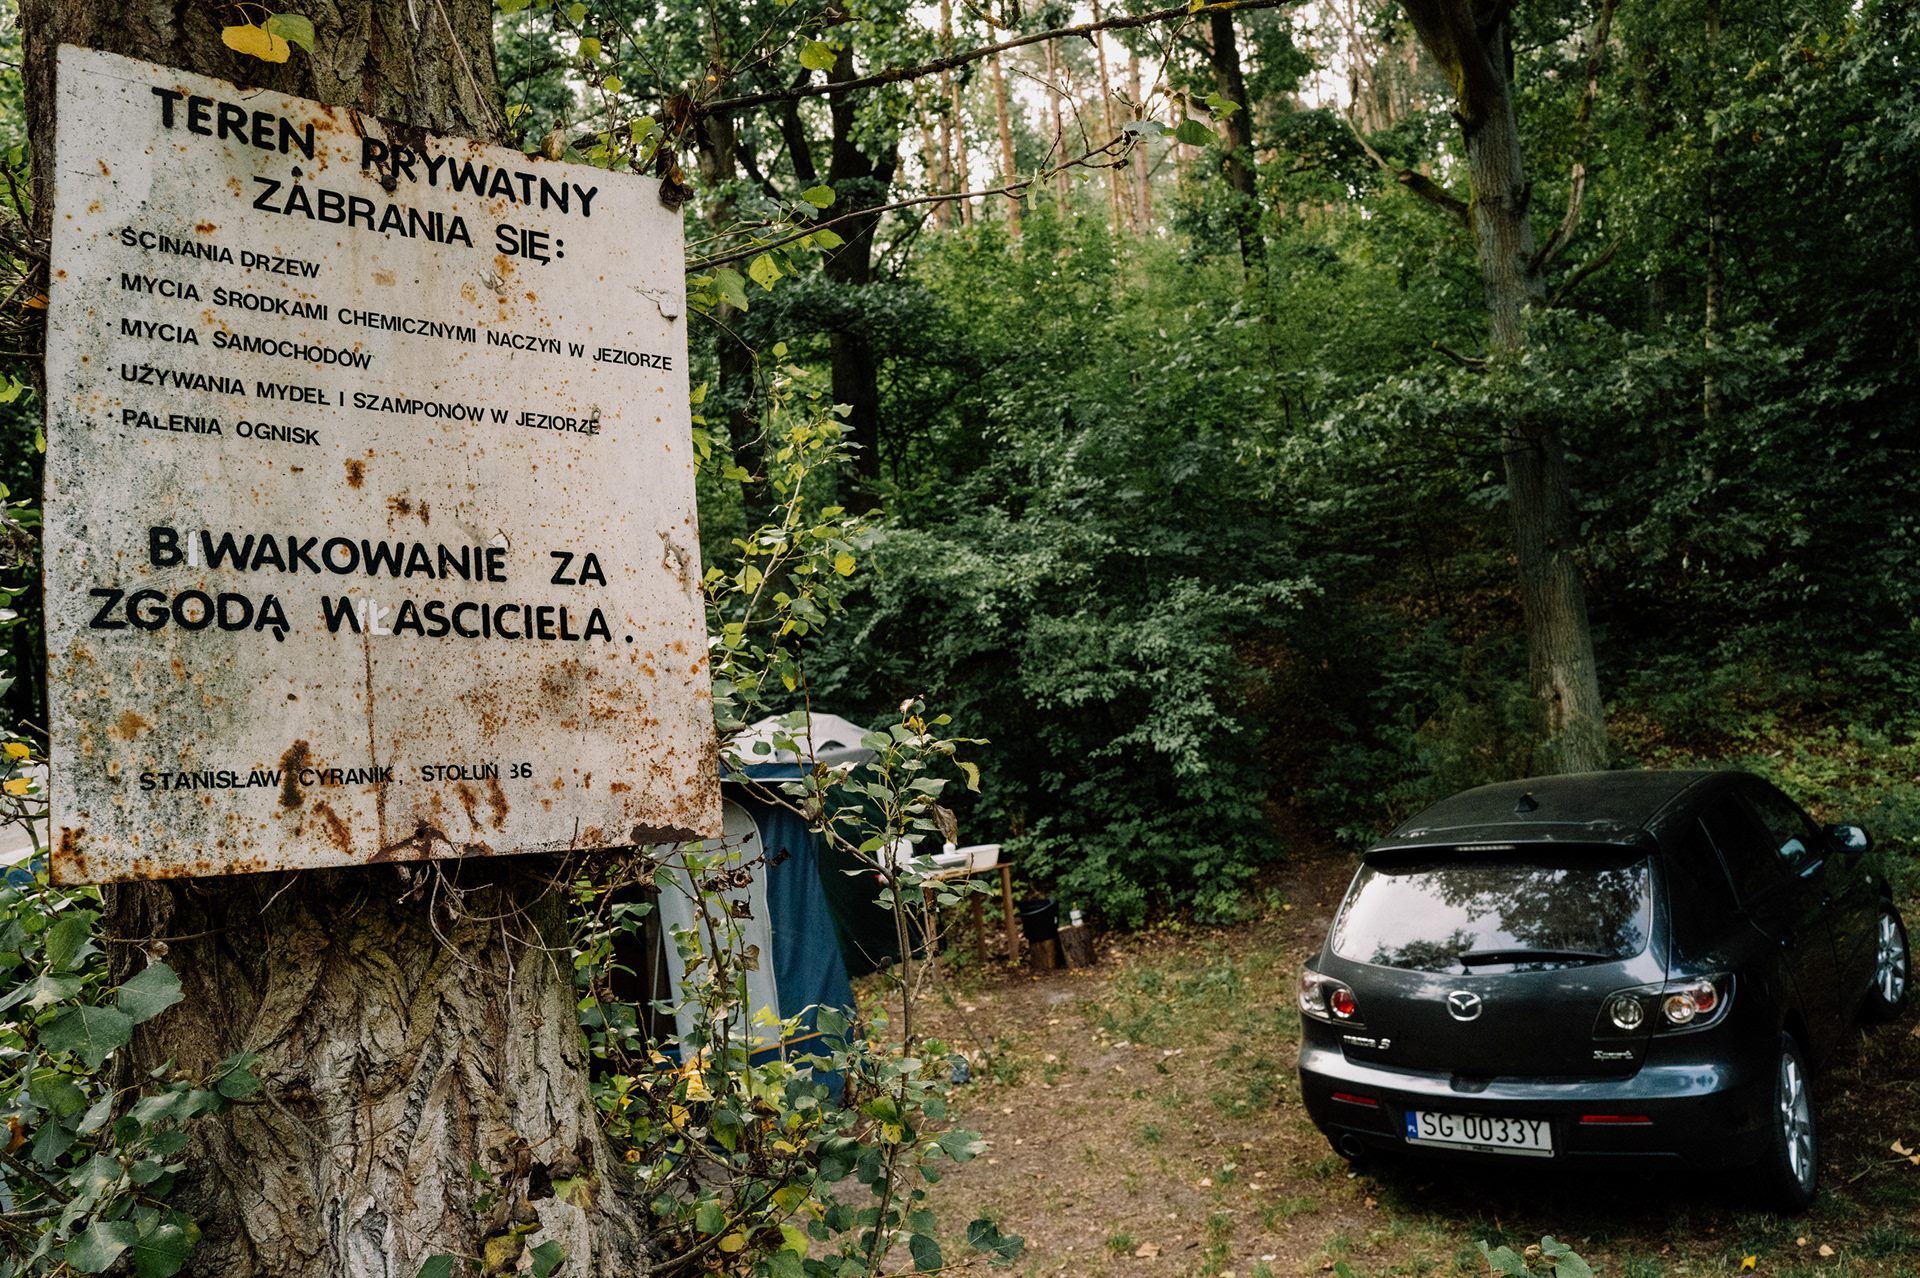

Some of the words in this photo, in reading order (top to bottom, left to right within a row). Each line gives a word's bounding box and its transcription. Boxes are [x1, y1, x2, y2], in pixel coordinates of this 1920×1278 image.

[152, 86, 315, 161] TEREN
[362, 136, 598, 218] PRYWATNY
[253, 175, 474, 248] ZABRANIA
[495, 223, 565, 266] SIĘ:
[121, 226, 234, 265] ŚCINANIA
[240, 250, 320, 279] DRZEW
[121, 273, 200, 302] MYCIA
[212, 287, 328, 321] ŚRODKAMI
[337, 308, 476, 344] CHEMICZNYMI
[487, 330, 561, 355] NACZYŃ
[568, 342, 585, 358] W
[592, 347, 673, 371] JEZIORZE
[121, 318, 199, 345] MYCIA
[212, 330, 372, 370] SAMOCHODÓW
[121, 363, 246, 396] UŻYWANIA
[256, 381, 331, 406] MYDEŁ
[339, 391, 345, 407] I
[353, 392, 485, 422] SZAMPONÓW
[490, 408, 509, 424] W
[515, 411, 600, 435] JEZIORZE
[122, 408, 223, 436] PALENIA
[235, 420, 321, 446] OGNISK
[150, 526, 508, 583] BIWAKOWANIE
[550, 550, 607, 587] ZA
[89, 588, 291, 643] ZGODĄ
[139, 769, 282, 791] STANISŁAW
[299, 766, 404, 787] CYRANIK,
[1407, 1124, 1417, 1133] PL
[1422, 1111, 1454, 1138] SG
[1463, 1115, 1542, 1146] 0033Y
